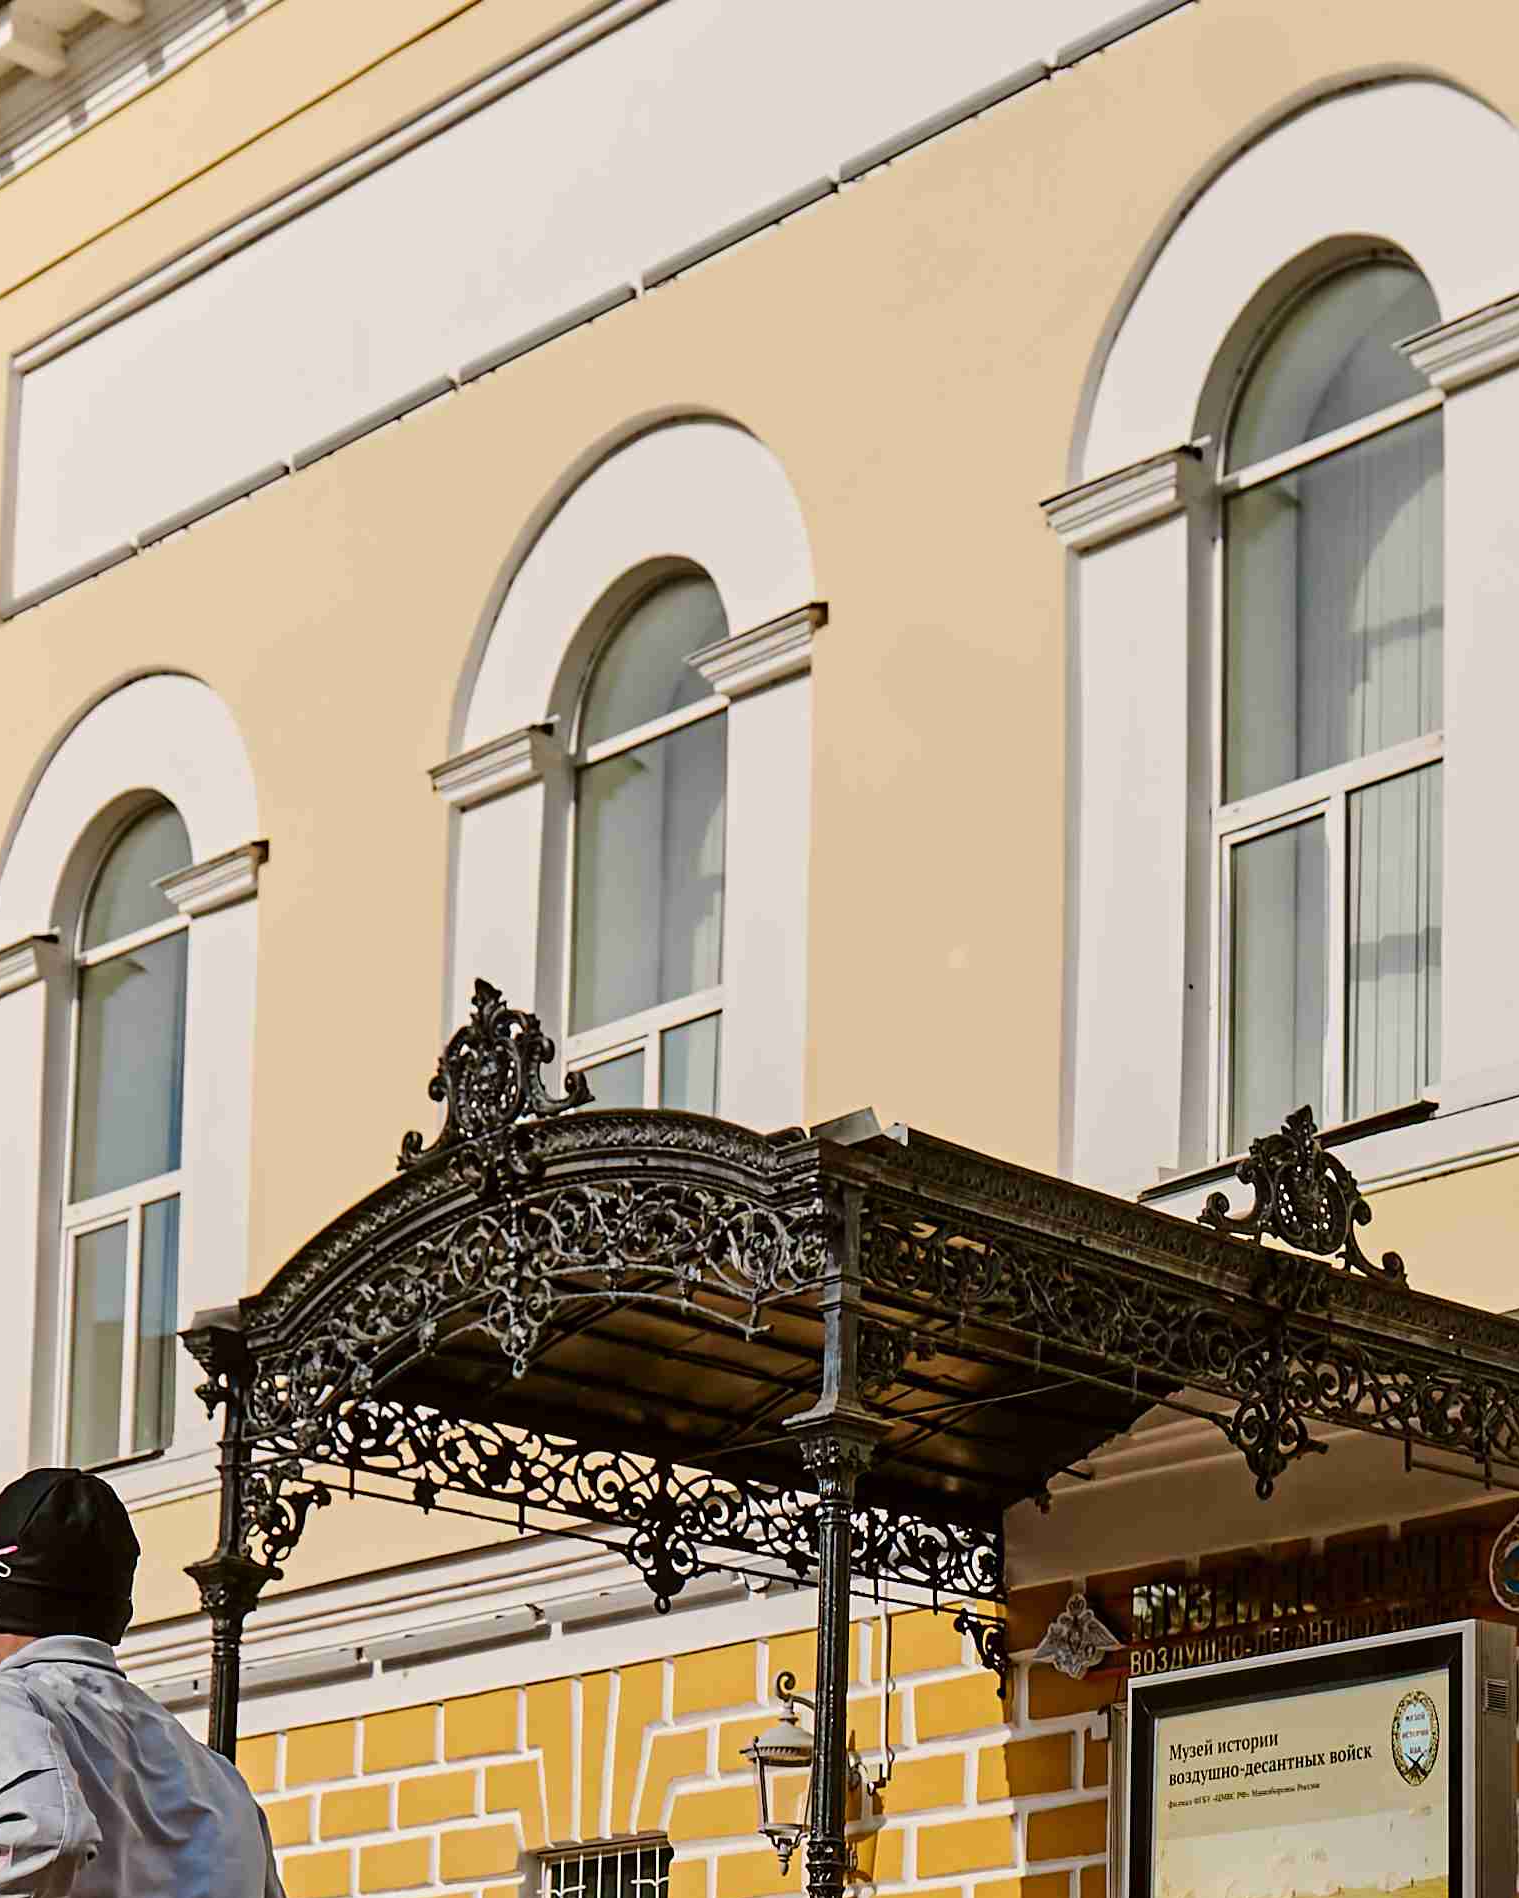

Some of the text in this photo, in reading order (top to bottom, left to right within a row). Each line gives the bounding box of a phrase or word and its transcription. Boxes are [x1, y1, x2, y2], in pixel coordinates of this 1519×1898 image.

[1169, 1733, 1279, 1764] Музей истории
[1169, 1744, 1373, 1786] воздушно-десантных войск
